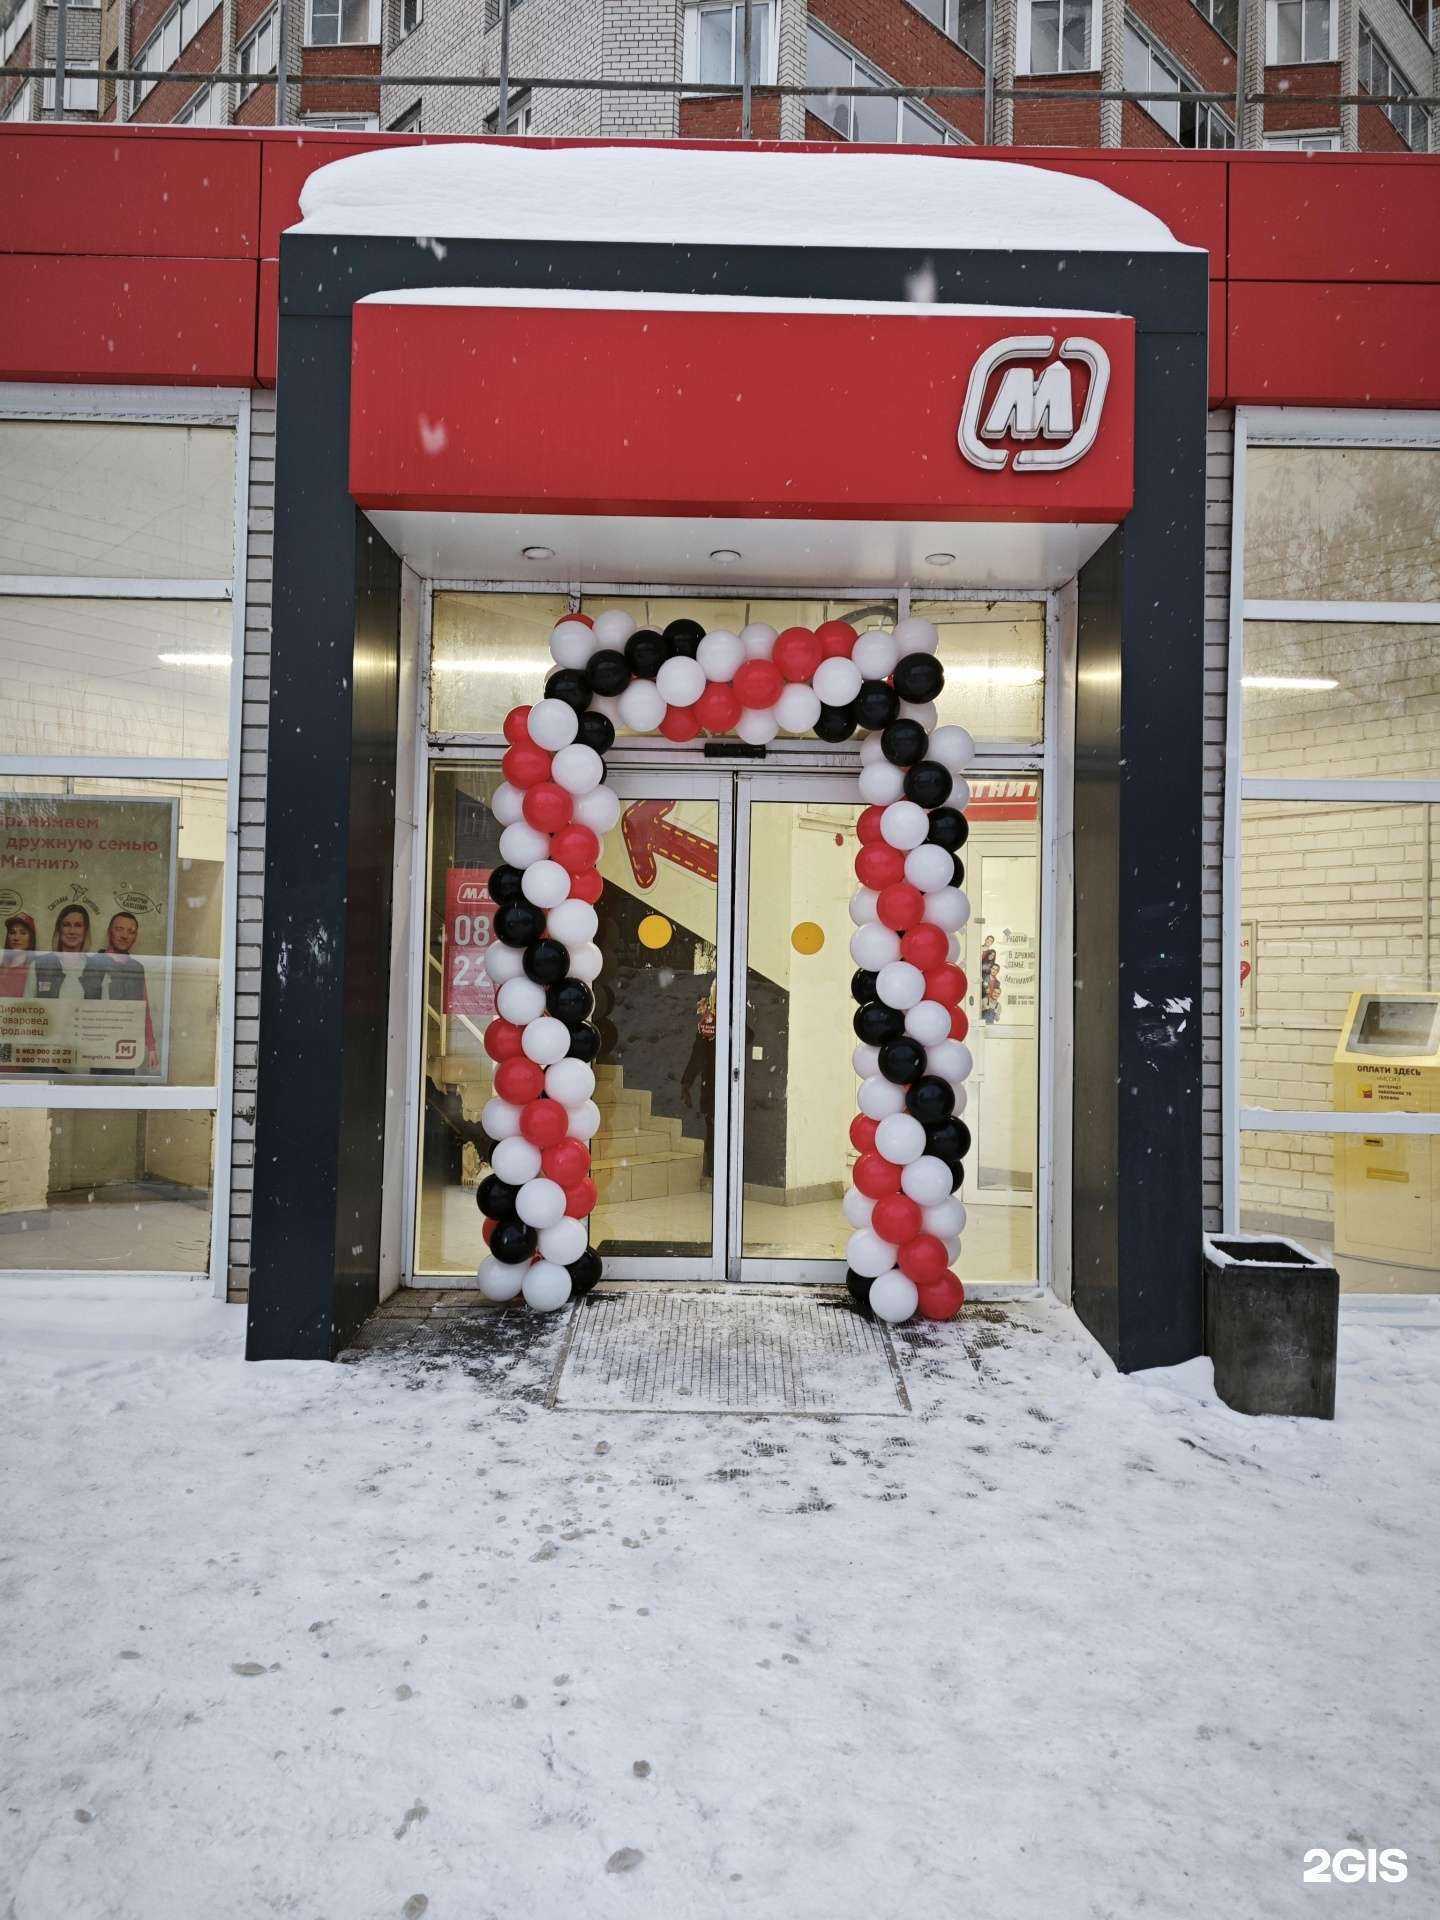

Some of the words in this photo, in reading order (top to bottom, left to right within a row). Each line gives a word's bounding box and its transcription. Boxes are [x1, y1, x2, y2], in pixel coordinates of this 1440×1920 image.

[6, 837, 93, 852] дружную
[98, 838, 160, 851] семью
[1, 854, 80, 870] Магнит»
[455, 915, 490, 946] 08
[0, 1028, 45, 1037] родавец
[1357, 1065, 1391, 1075] ОПЛАТИ
[1393, 1067, 1421, 1076] ЗДЕСЬ
